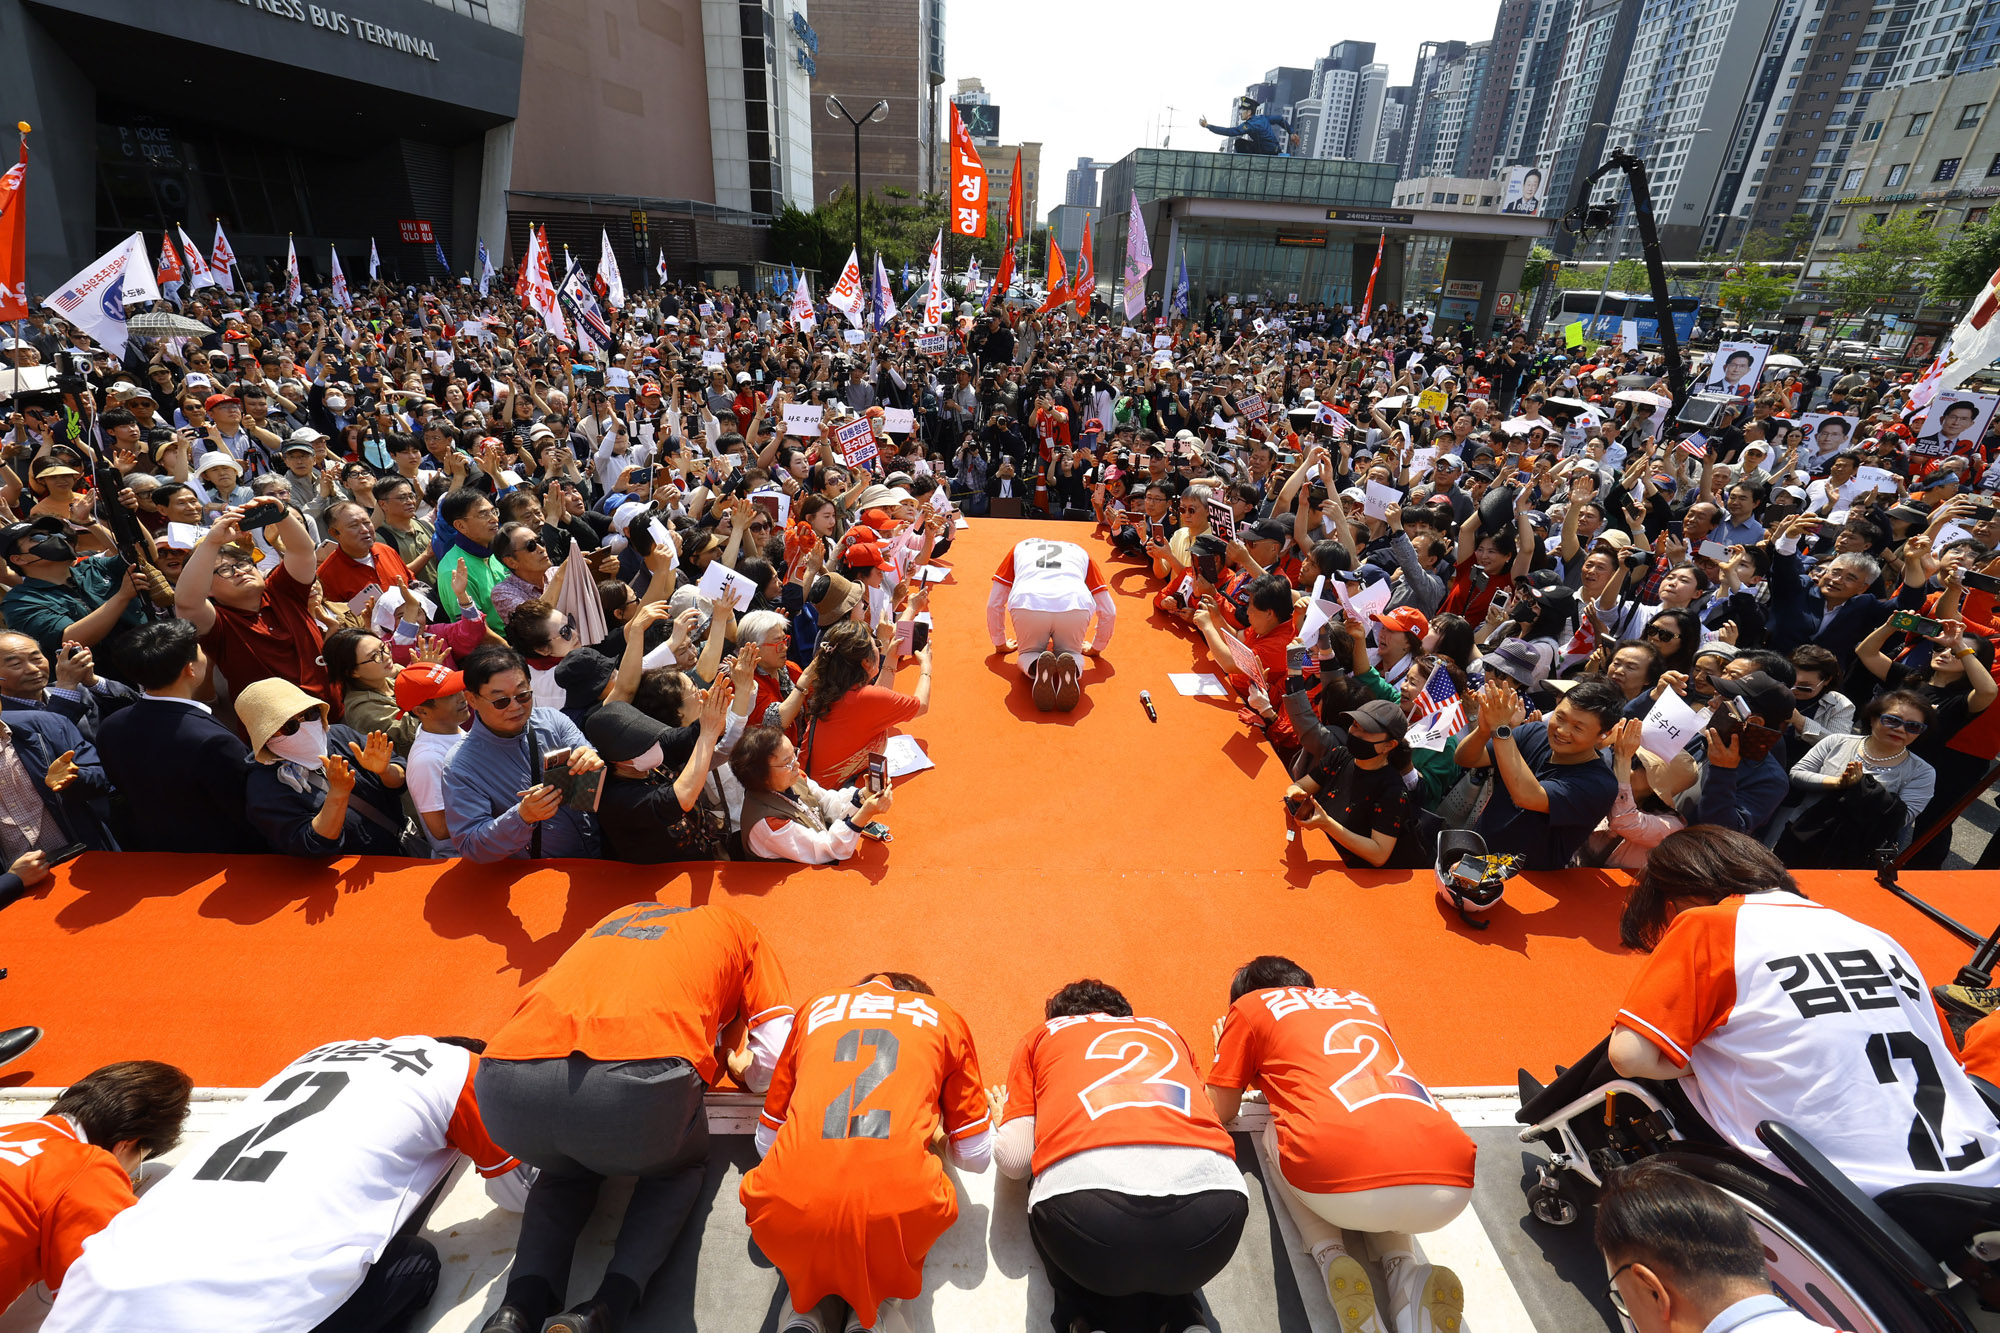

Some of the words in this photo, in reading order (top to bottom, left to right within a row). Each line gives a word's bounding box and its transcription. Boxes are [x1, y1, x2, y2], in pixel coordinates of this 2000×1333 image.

[240, 0, 306, 22] RESS
[308, 4, 350, 35] BUS
[351, 17, 440, 62] TERMINAL
[121, 143, 175, 158] CDDIE
[400, 223, 417, 231] UNI
[403, 232, 420, 241] QLO
[419, 223, 431, 231] UNI
[422, 232, 433, 241] QLO
[921, 335, 945, 346] 부정선거
[839, 421, 870, 442] 대통령은
[848, 455, 855, 465] 2
[854, 445, 876, 462] 김문수
[1915, 443, 1952, 457] 김문수
[1952, 440, 1974, 457] 2
[1036, 544, 1063, 569] 2
[1650, 712, 1681, 740] 문수다
[1766, 949, 1921, 1019] 김문수
[807, 991, 939, 1036] 김문수
[1078, 1029, 1190, 1120] 2
[1323, 1019, 1439, 1112] 2
[821, 1028, 901, 1140] 2
[194, 1070, 351, 1183] 2
